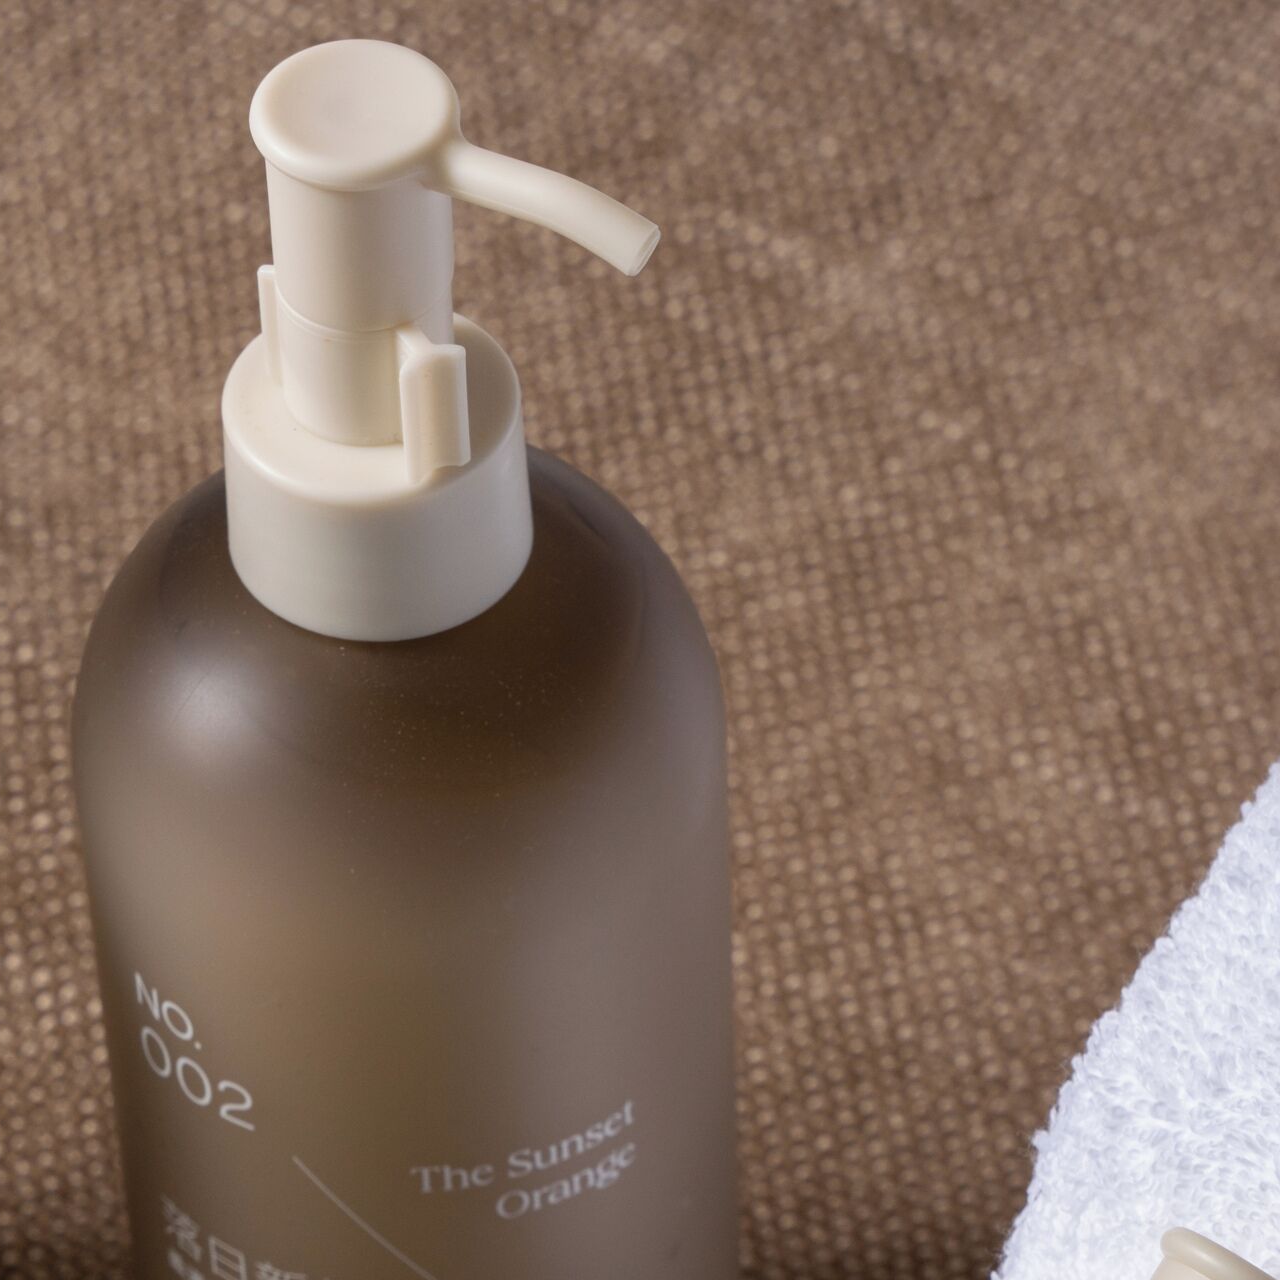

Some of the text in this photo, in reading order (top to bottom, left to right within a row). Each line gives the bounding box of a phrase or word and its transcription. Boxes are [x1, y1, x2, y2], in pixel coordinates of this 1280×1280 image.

[133, 971, 204, 1051] NO.
[140, 1026, 256, 1132] 002
[410, 1100, 637, 1194] The Sunset
[495, 1140, 639, 1220] Orange
